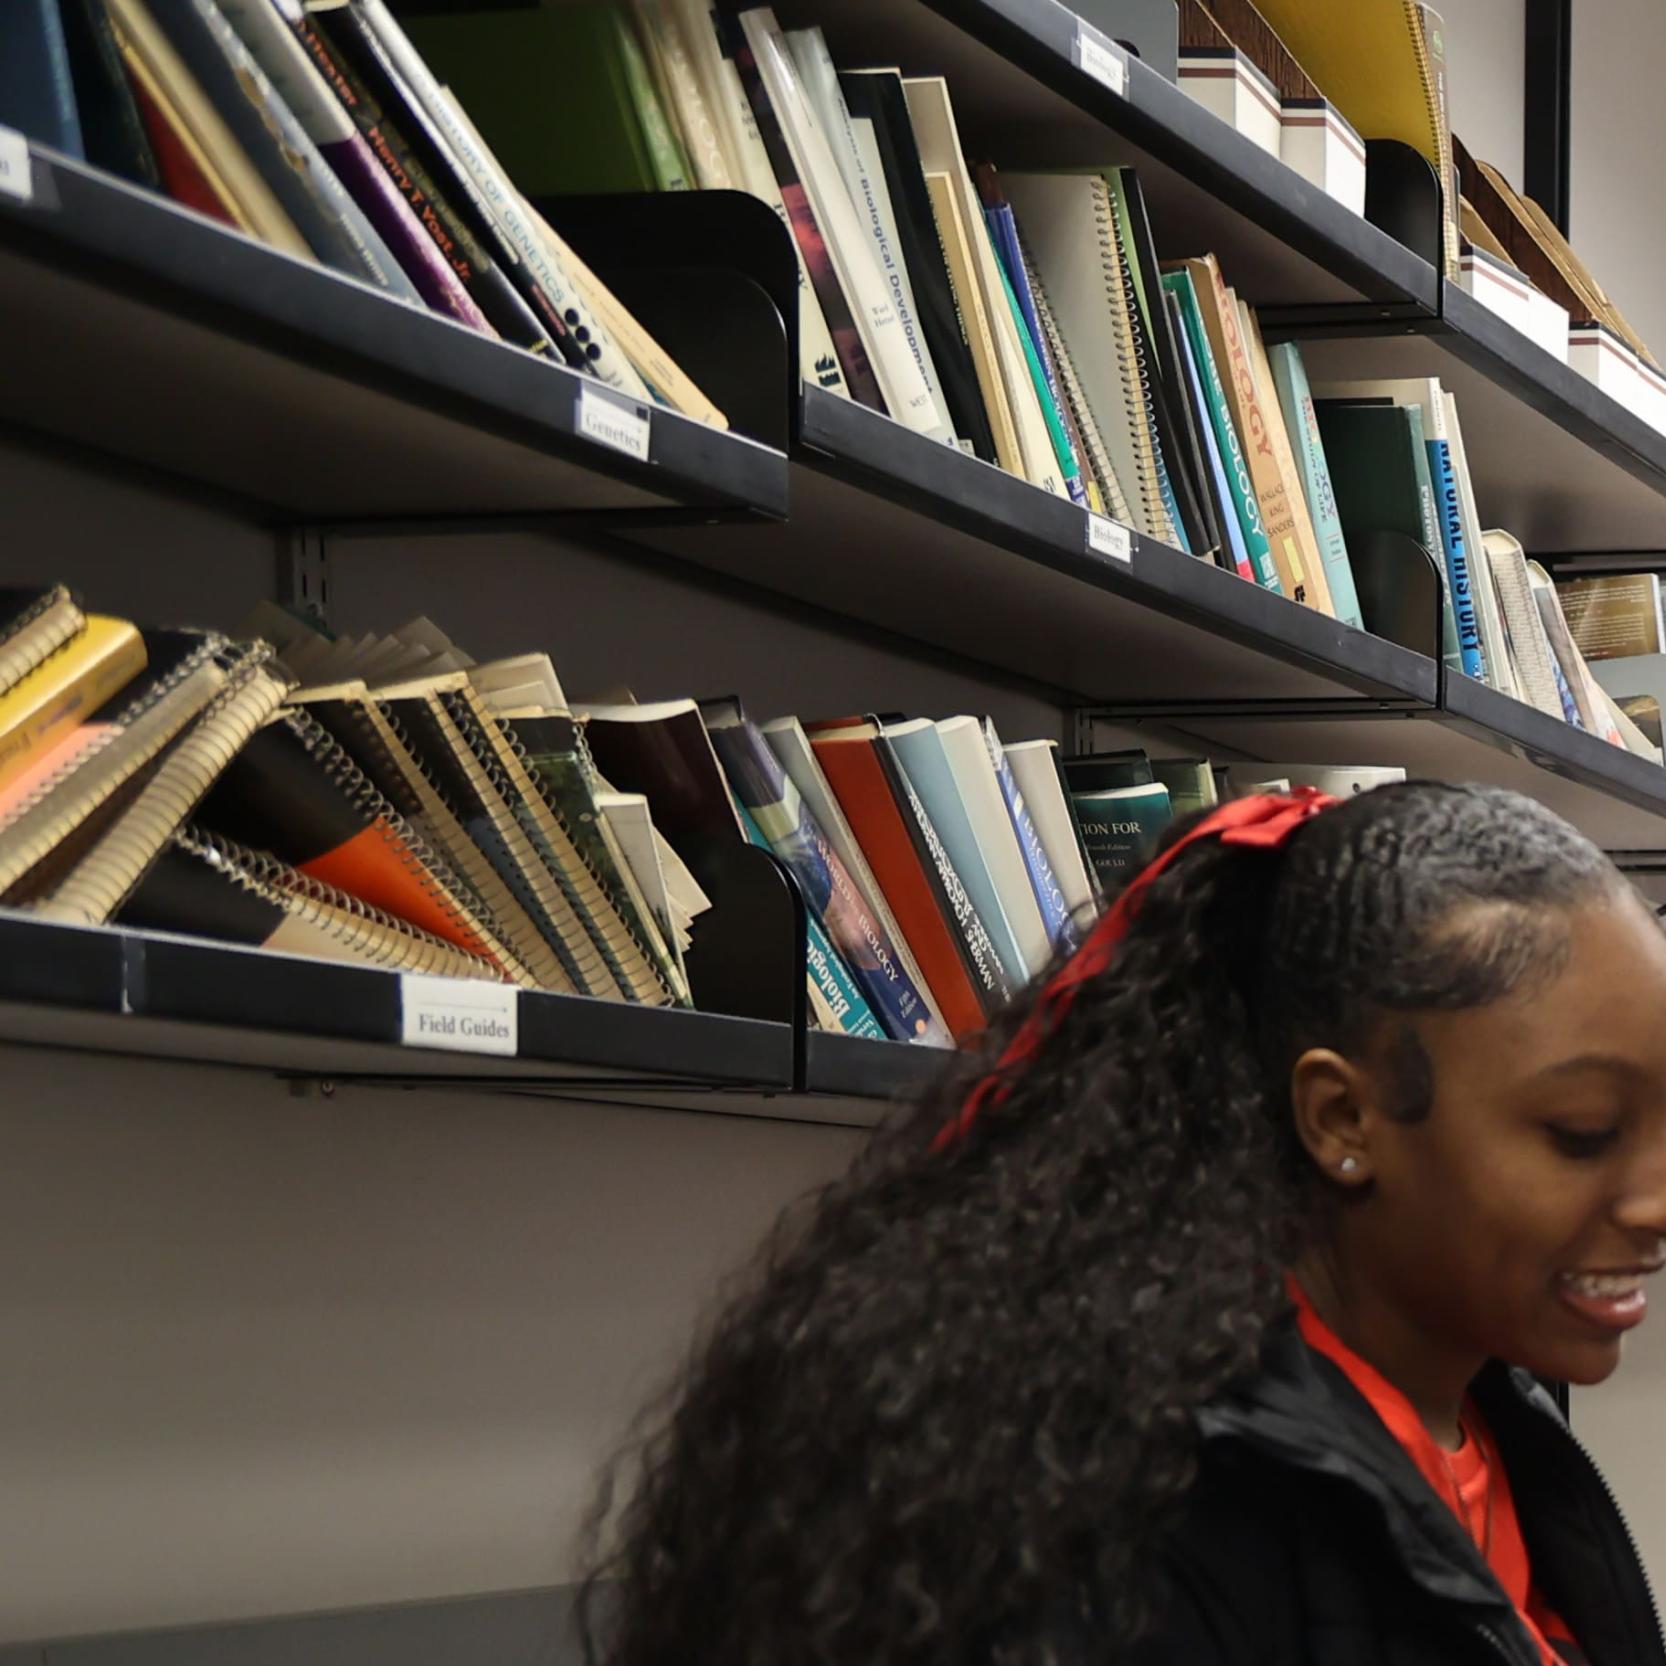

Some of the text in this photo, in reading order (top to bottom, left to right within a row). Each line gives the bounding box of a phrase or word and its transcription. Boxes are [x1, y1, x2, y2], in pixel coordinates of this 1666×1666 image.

[503, 209, 566, 304] GENETICS
[859, 178, 896, 271] Biological
[586, 411, 642, 453] Genetics
[1220, 403, 1264, 538] BIOLOGY
[1440, 442, 1462, 549] NATURAL
[1112, 821, 1142, 834] FOR
[806, 938, 850, 1019] Biologic
[858, 912, 899, 983] BIOLOGY
[419, 1013, 510, 1039] Field Guides
